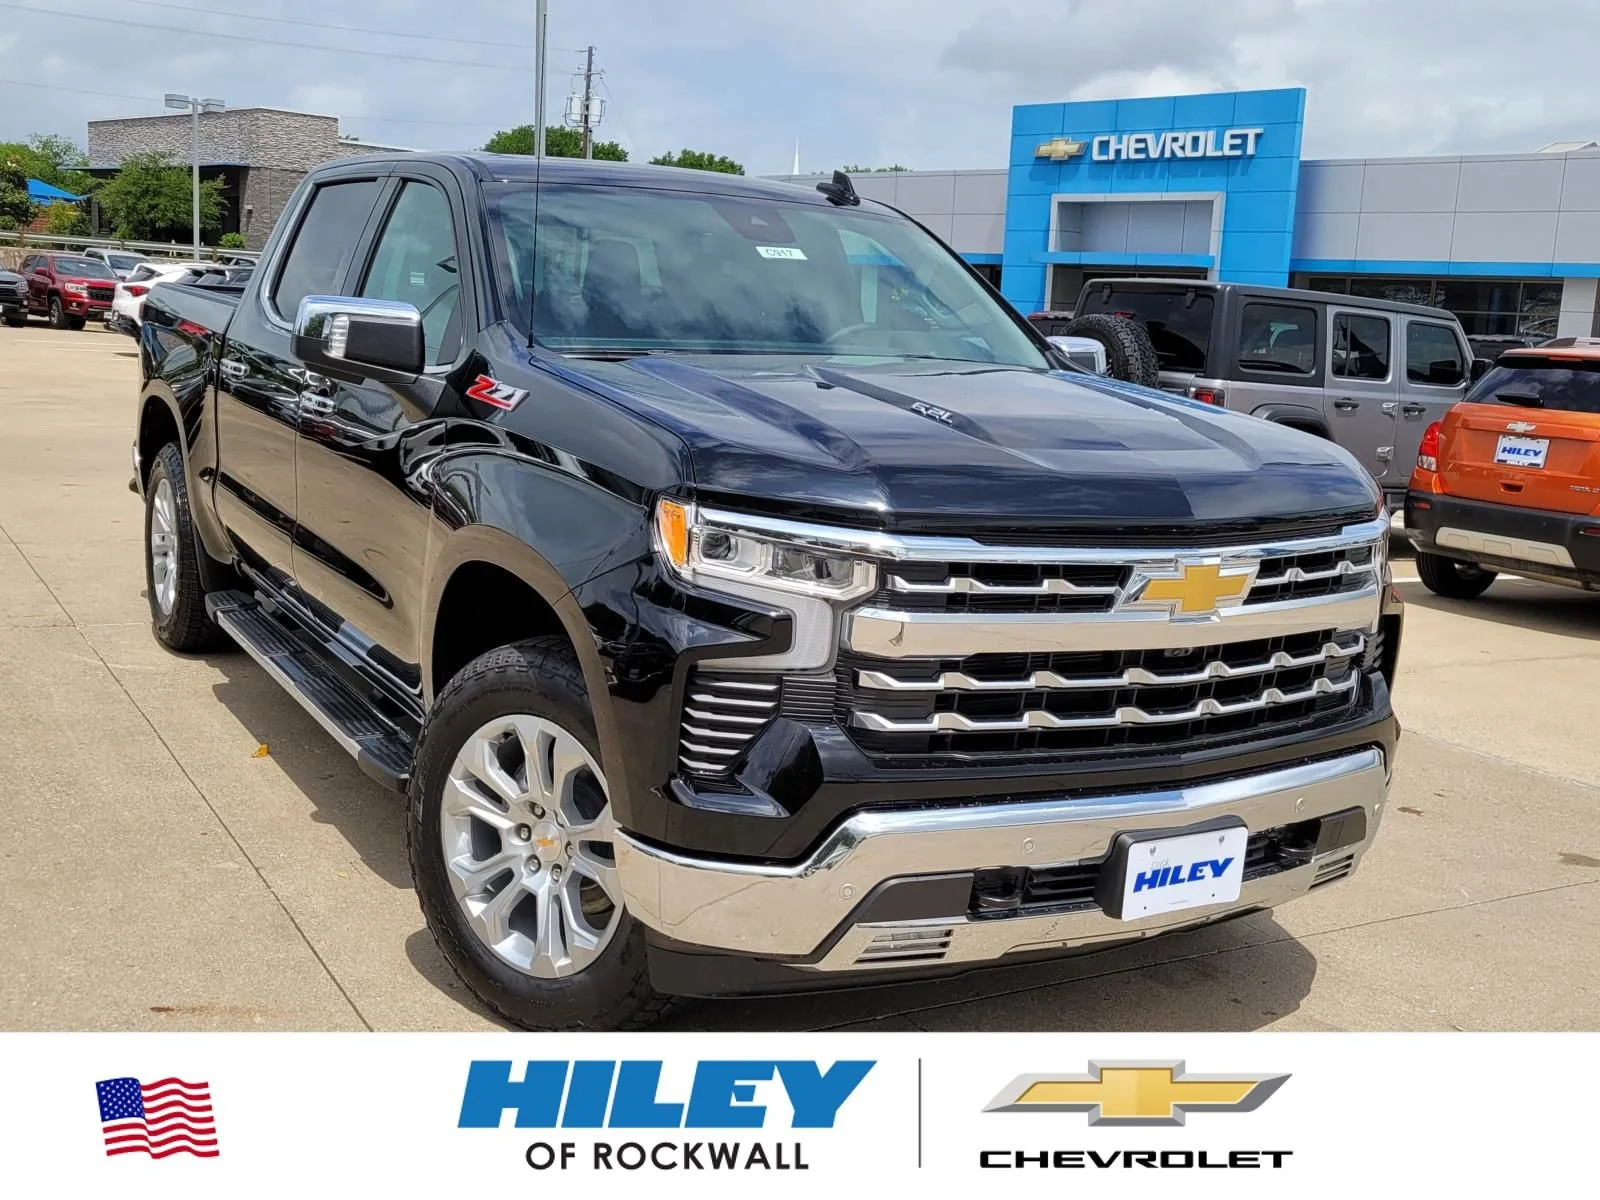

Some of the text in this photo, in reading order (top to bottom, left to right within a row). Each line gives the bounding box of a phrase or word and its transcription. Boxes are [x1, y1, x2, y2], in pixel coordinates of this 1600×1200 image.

[1092, 128, 1264, 161] CHEVROLET
[465, 374, 530, 412] Z71
[1501, 446, 1542, 457] HILEY
[1133, 857, 1234, 893] HILEY
